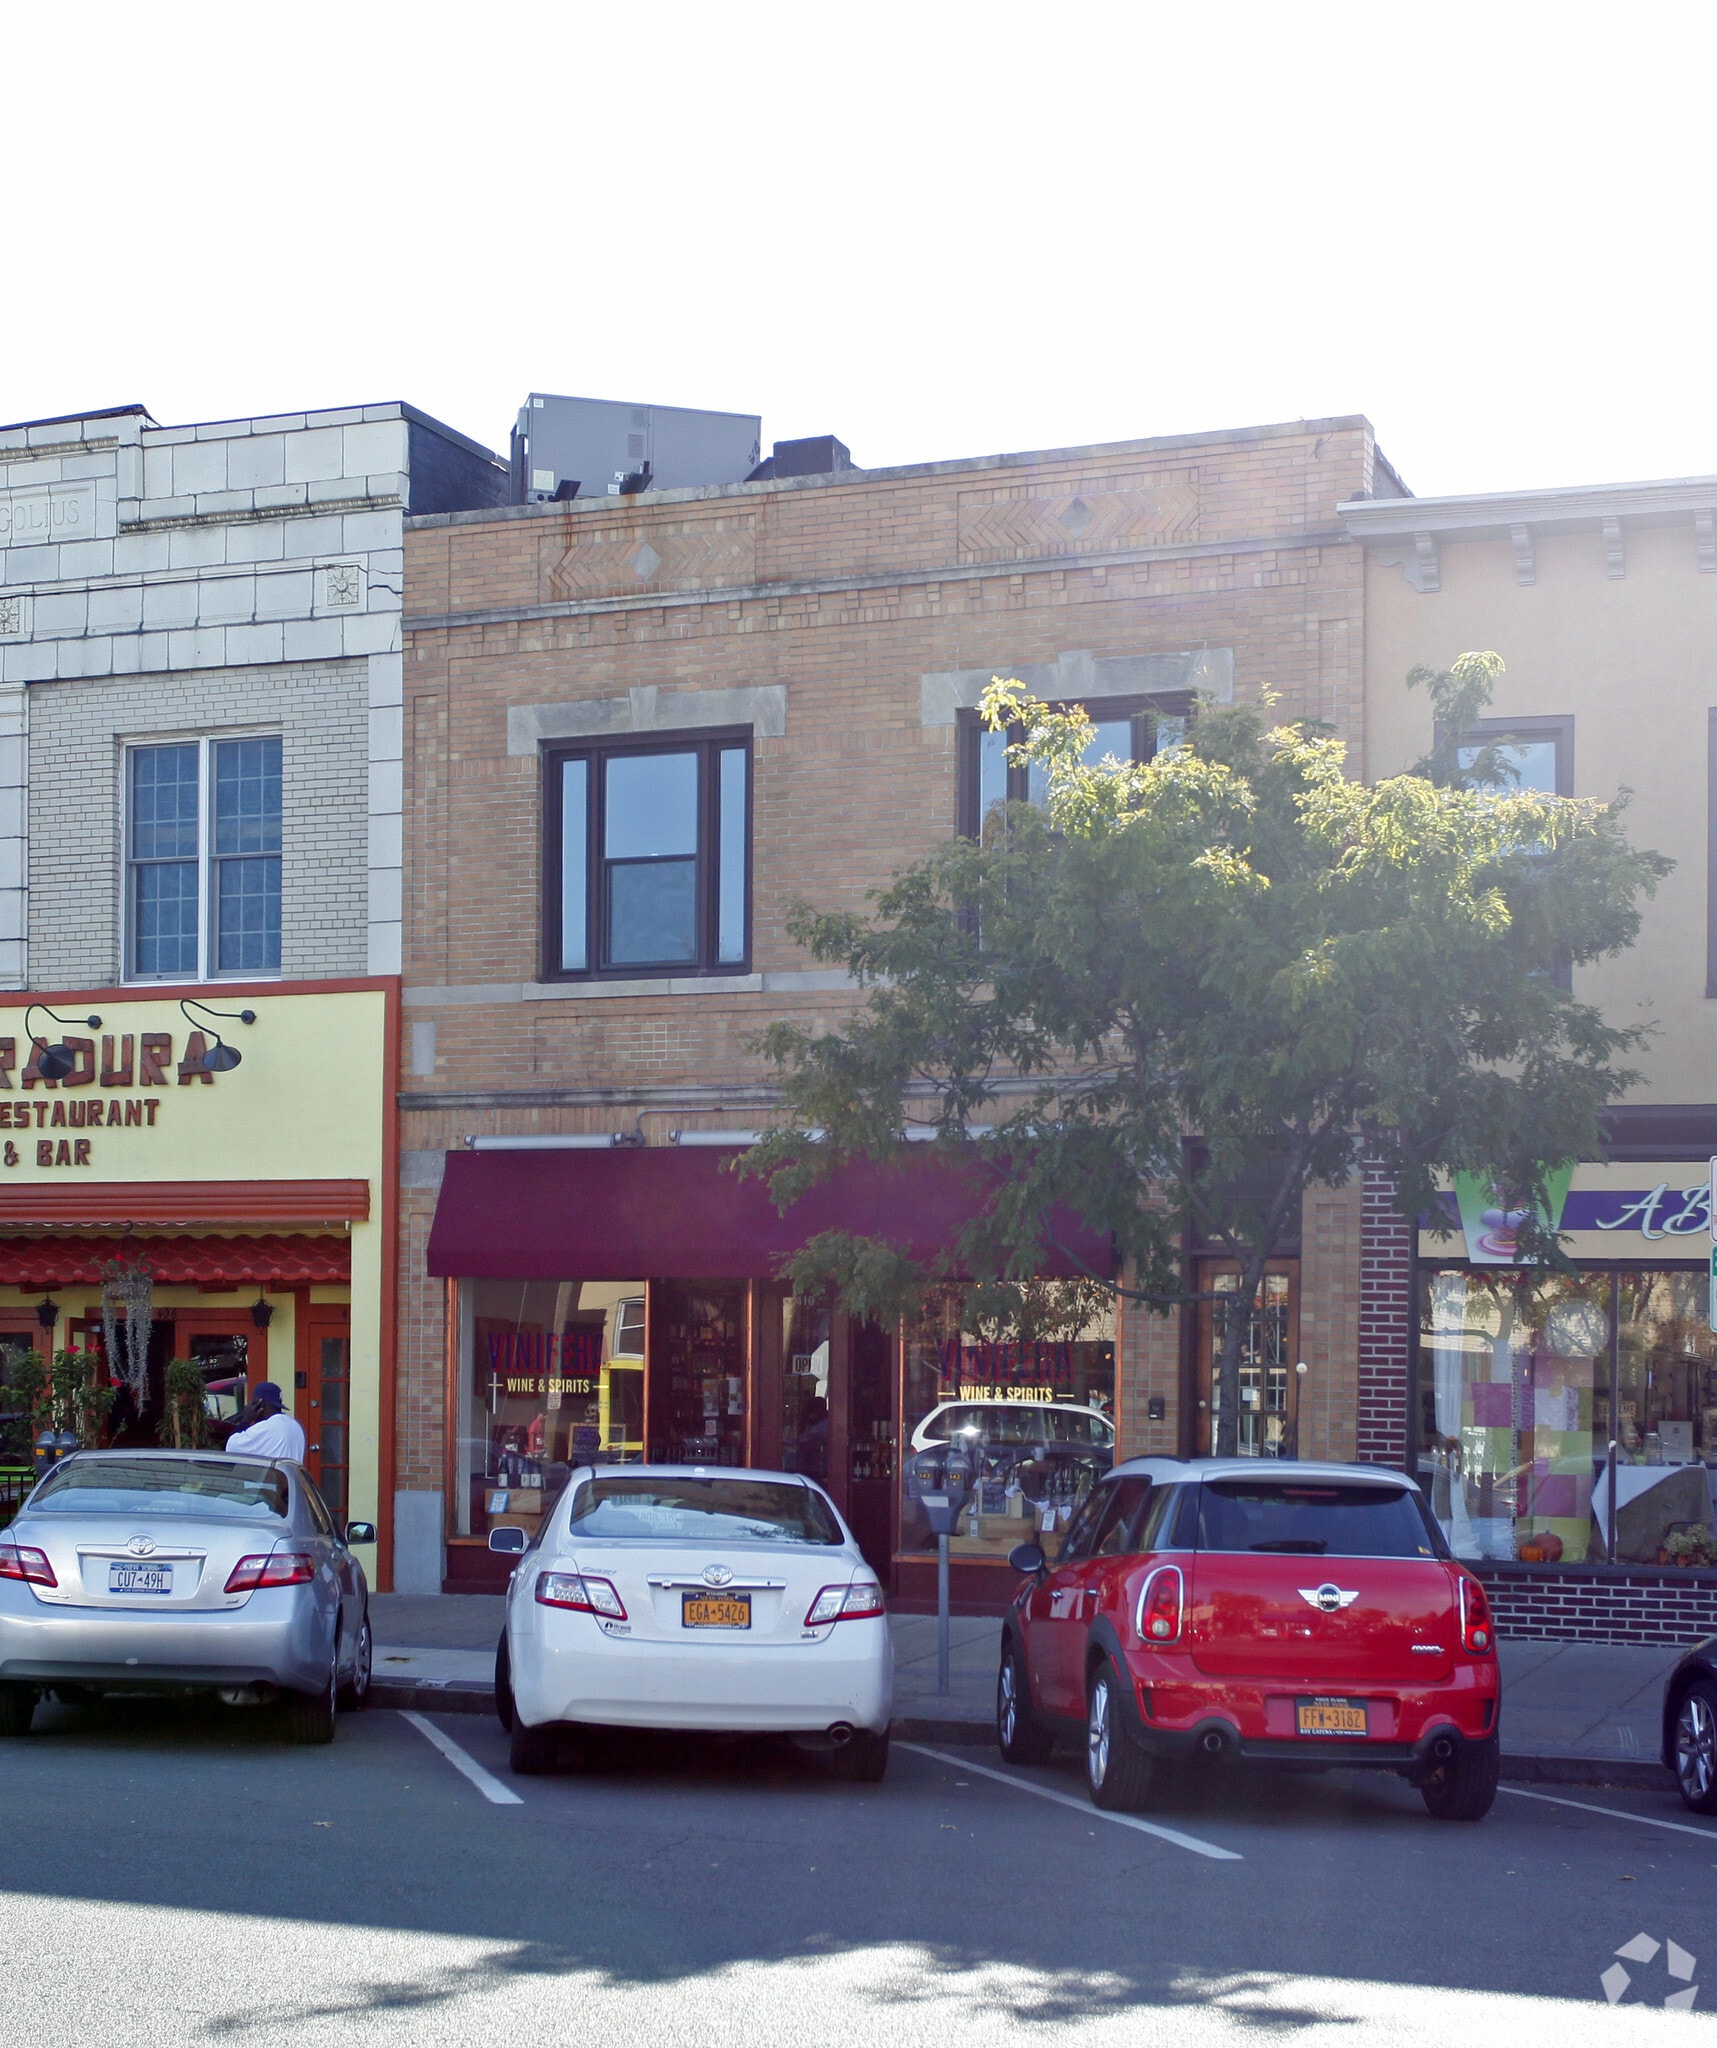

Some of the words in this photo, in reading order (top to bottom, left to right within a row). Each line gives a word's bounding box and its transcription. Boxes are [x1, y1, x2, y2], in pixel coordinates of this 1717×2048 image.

[4, 1140, 19, 1167] &
[36, 1138, 90, 1167] BAR
[487, 1331, 609, 1374] VINIFERA
[507, 1378, 535, 1393] WINE
[538, 1378, 546, 1393] &
[548, 1378, 590, 1394] SPIRITS
[959, 1386, 991, 1402] WINE
[994, 1386, 1003, 1402] &
[1006, 1386, 1053, 1403] SPIRITS
[1319, 1593, 1339, 1603] MINI
